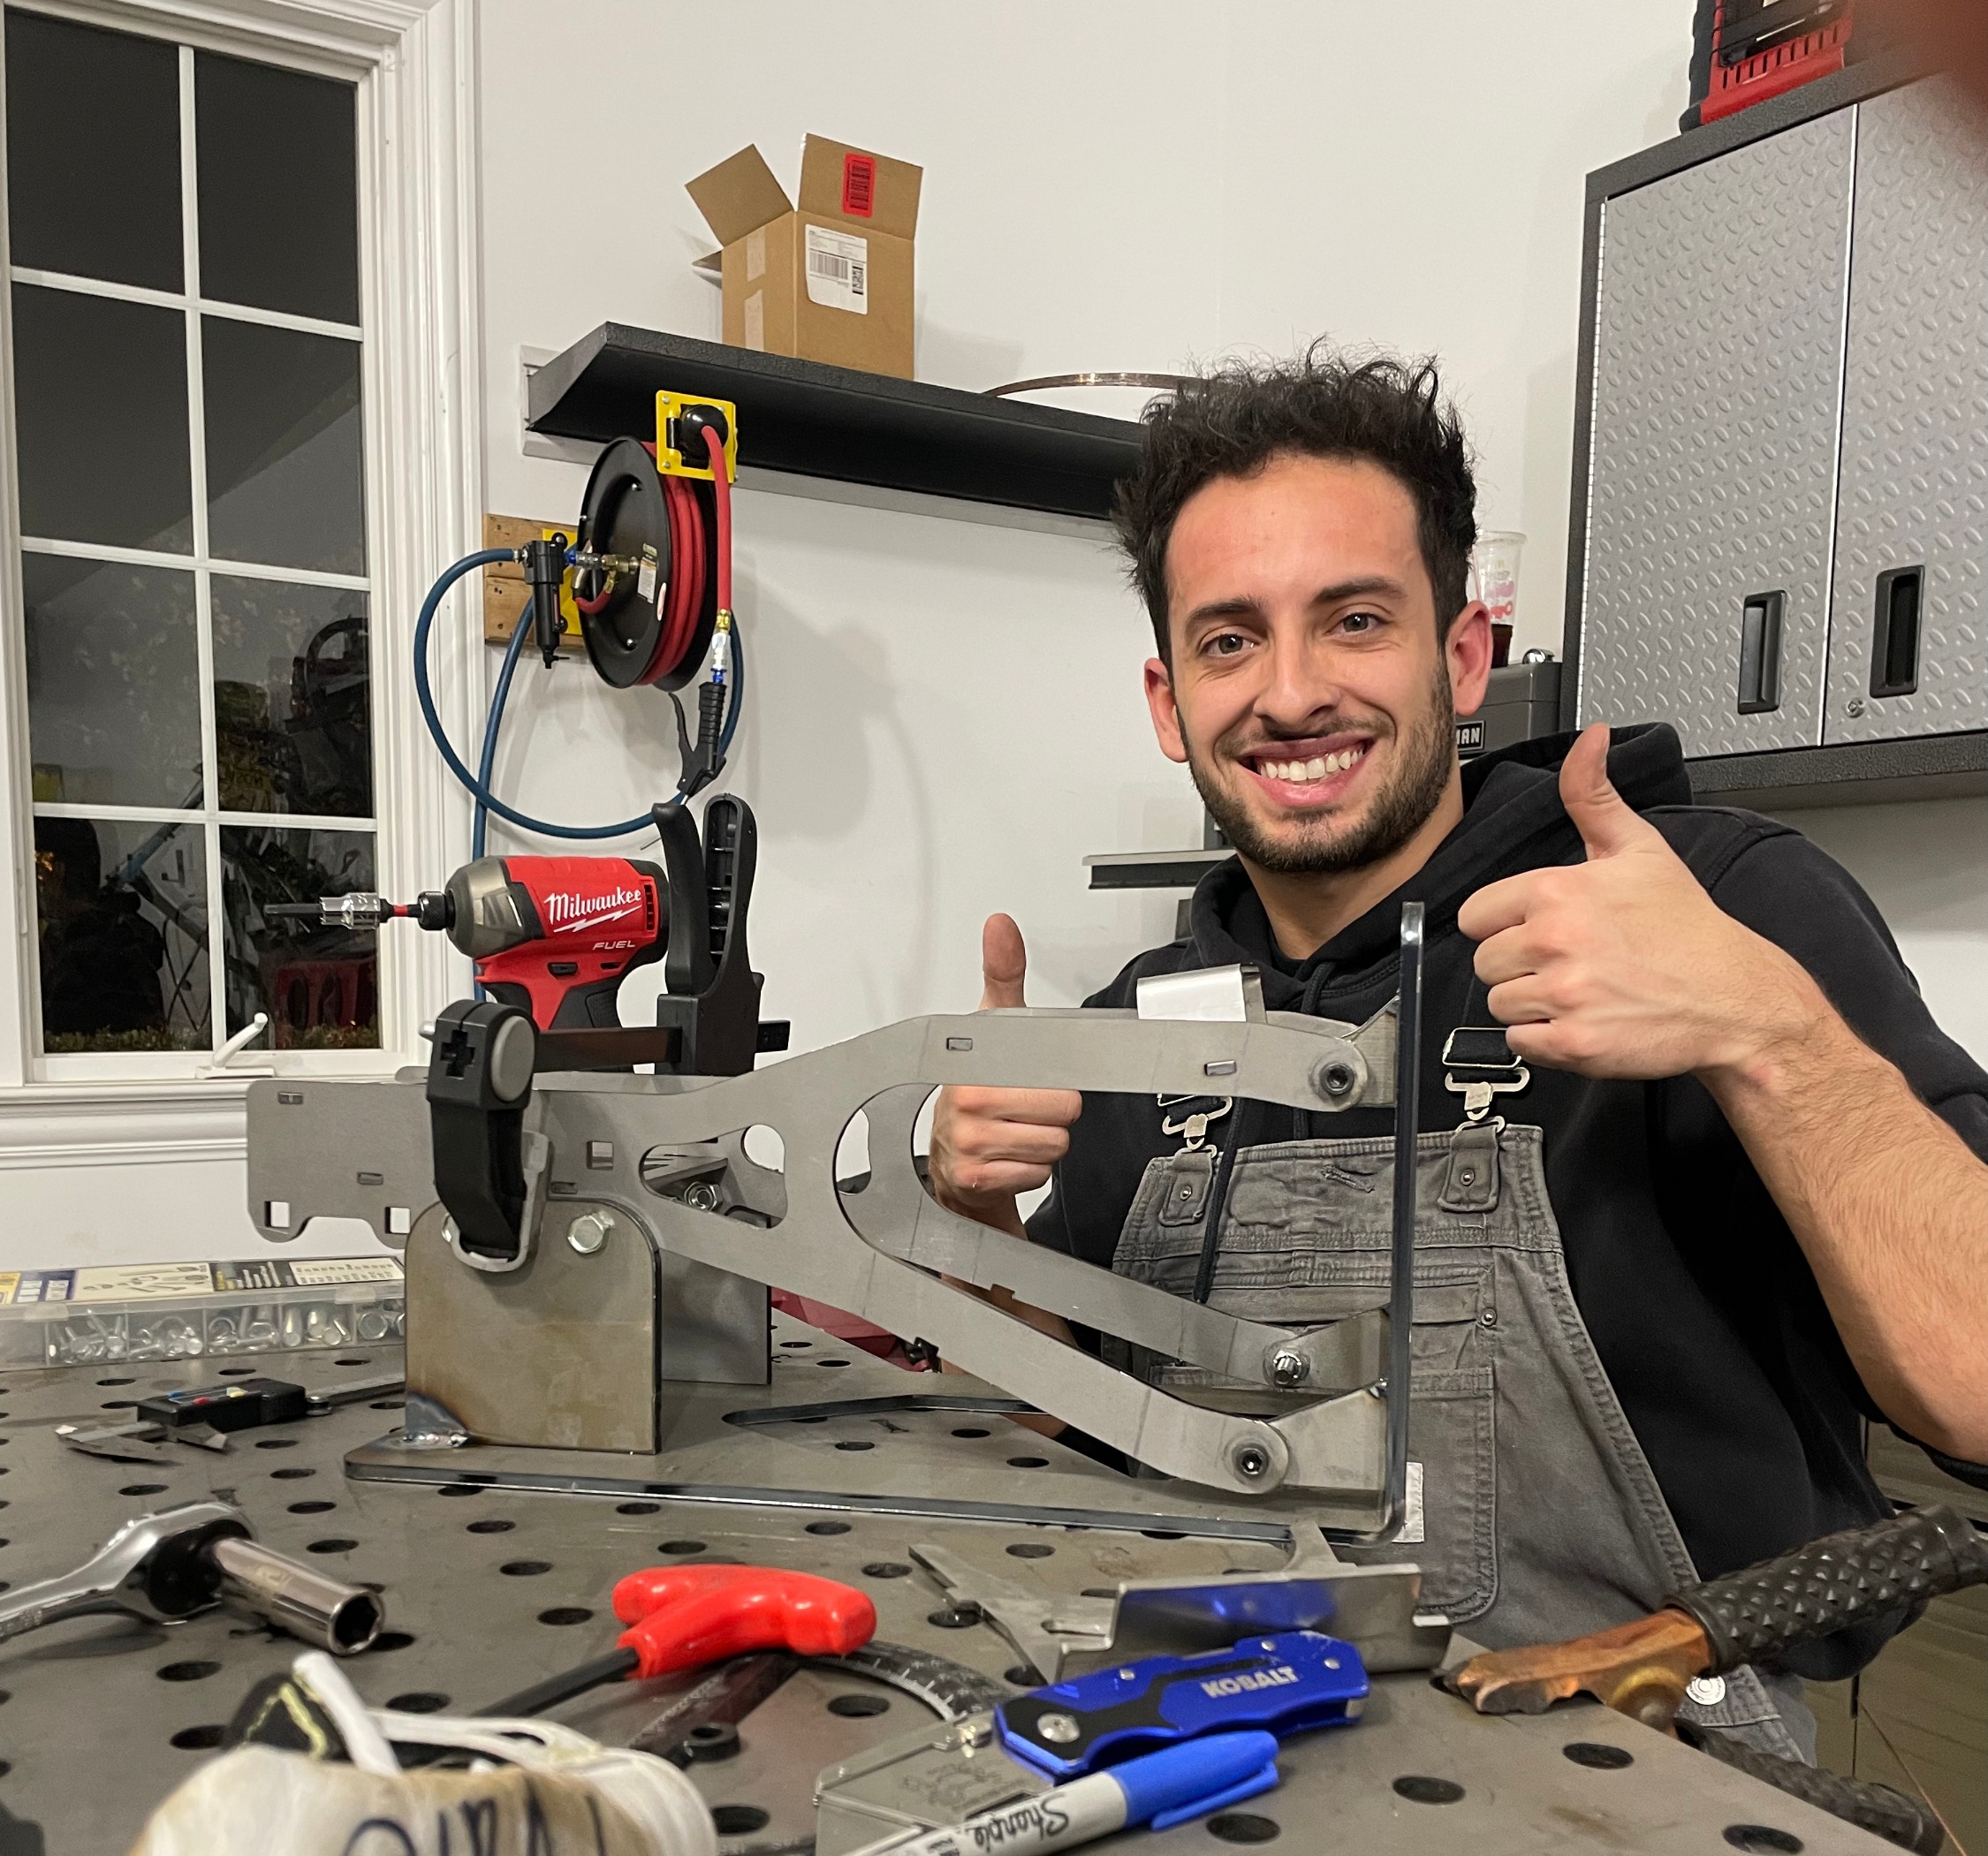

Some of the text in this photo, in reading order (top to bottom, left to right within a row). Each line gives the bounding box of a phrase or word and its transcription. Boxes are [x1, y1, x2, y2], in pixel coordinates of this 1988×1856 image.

[543, 886, 641, 924] Milwaukee
[593, 940, 635, 951] FUEL
[1200, 1665, 1300, 1698] KOBALT
[965, 1791, 1069, 1853] Sharpie
